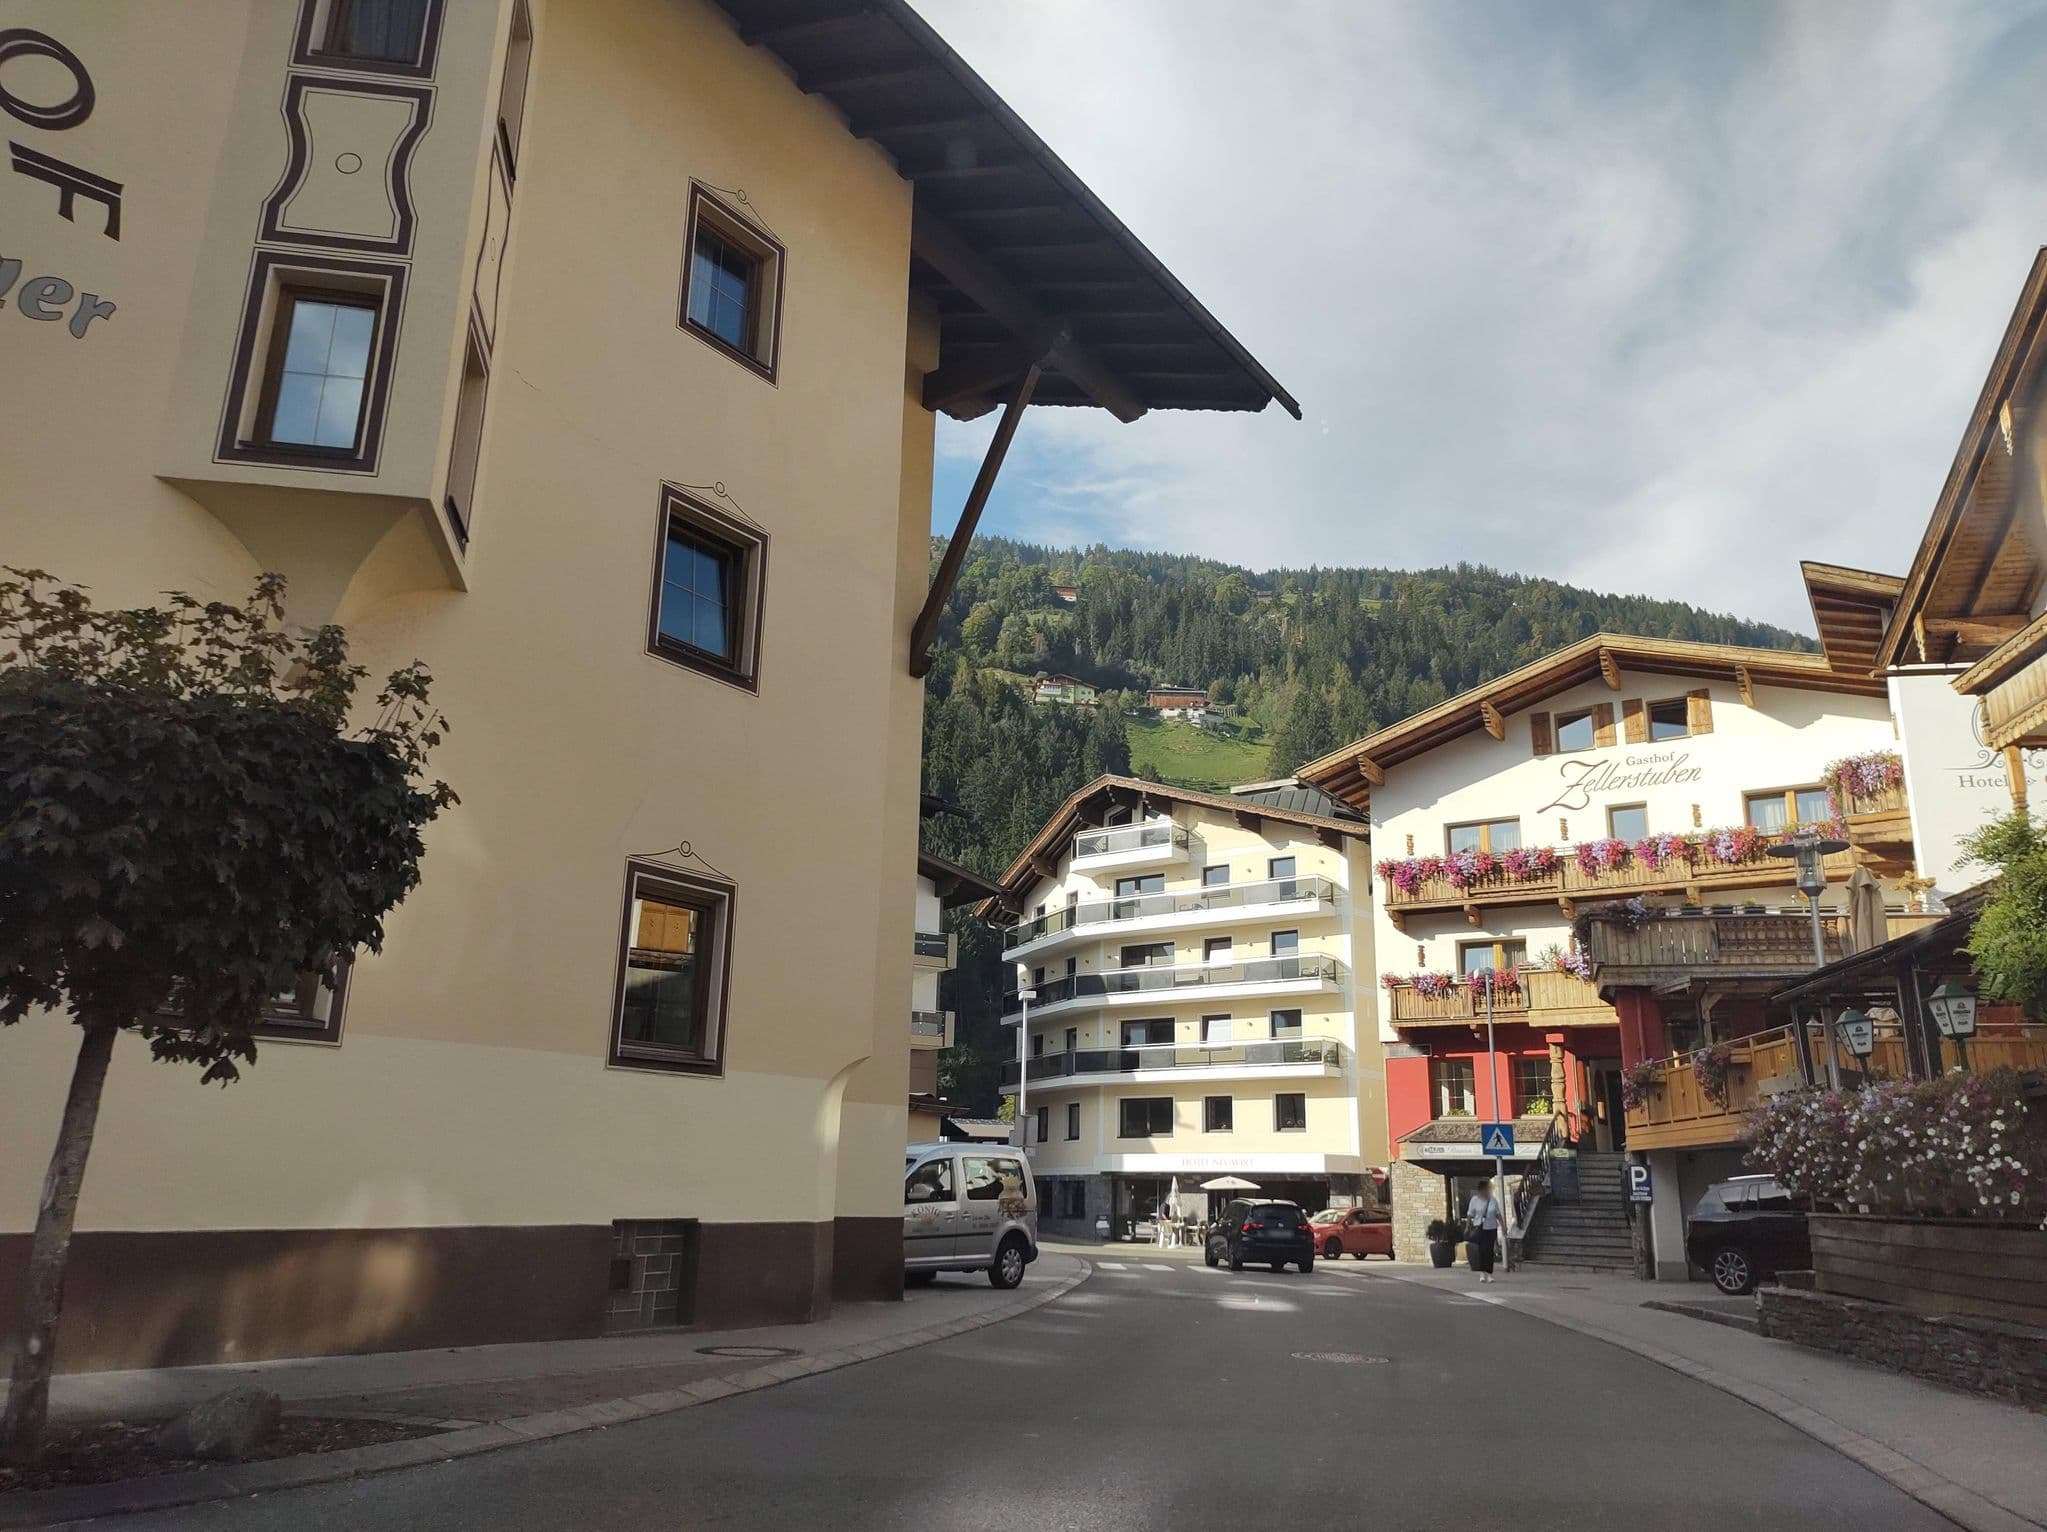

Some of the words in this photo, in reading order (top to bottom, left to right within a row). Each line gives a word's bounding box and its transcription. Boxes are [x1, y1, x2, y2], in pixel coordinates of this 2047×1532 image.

[1625, 751, 1676, 767] Gasthof
[1536, 753, 1702, 814] Zellerstuben
[1958, 774, 2009, 788] Hotel
[1630, 1166, 1648, 1191] P
